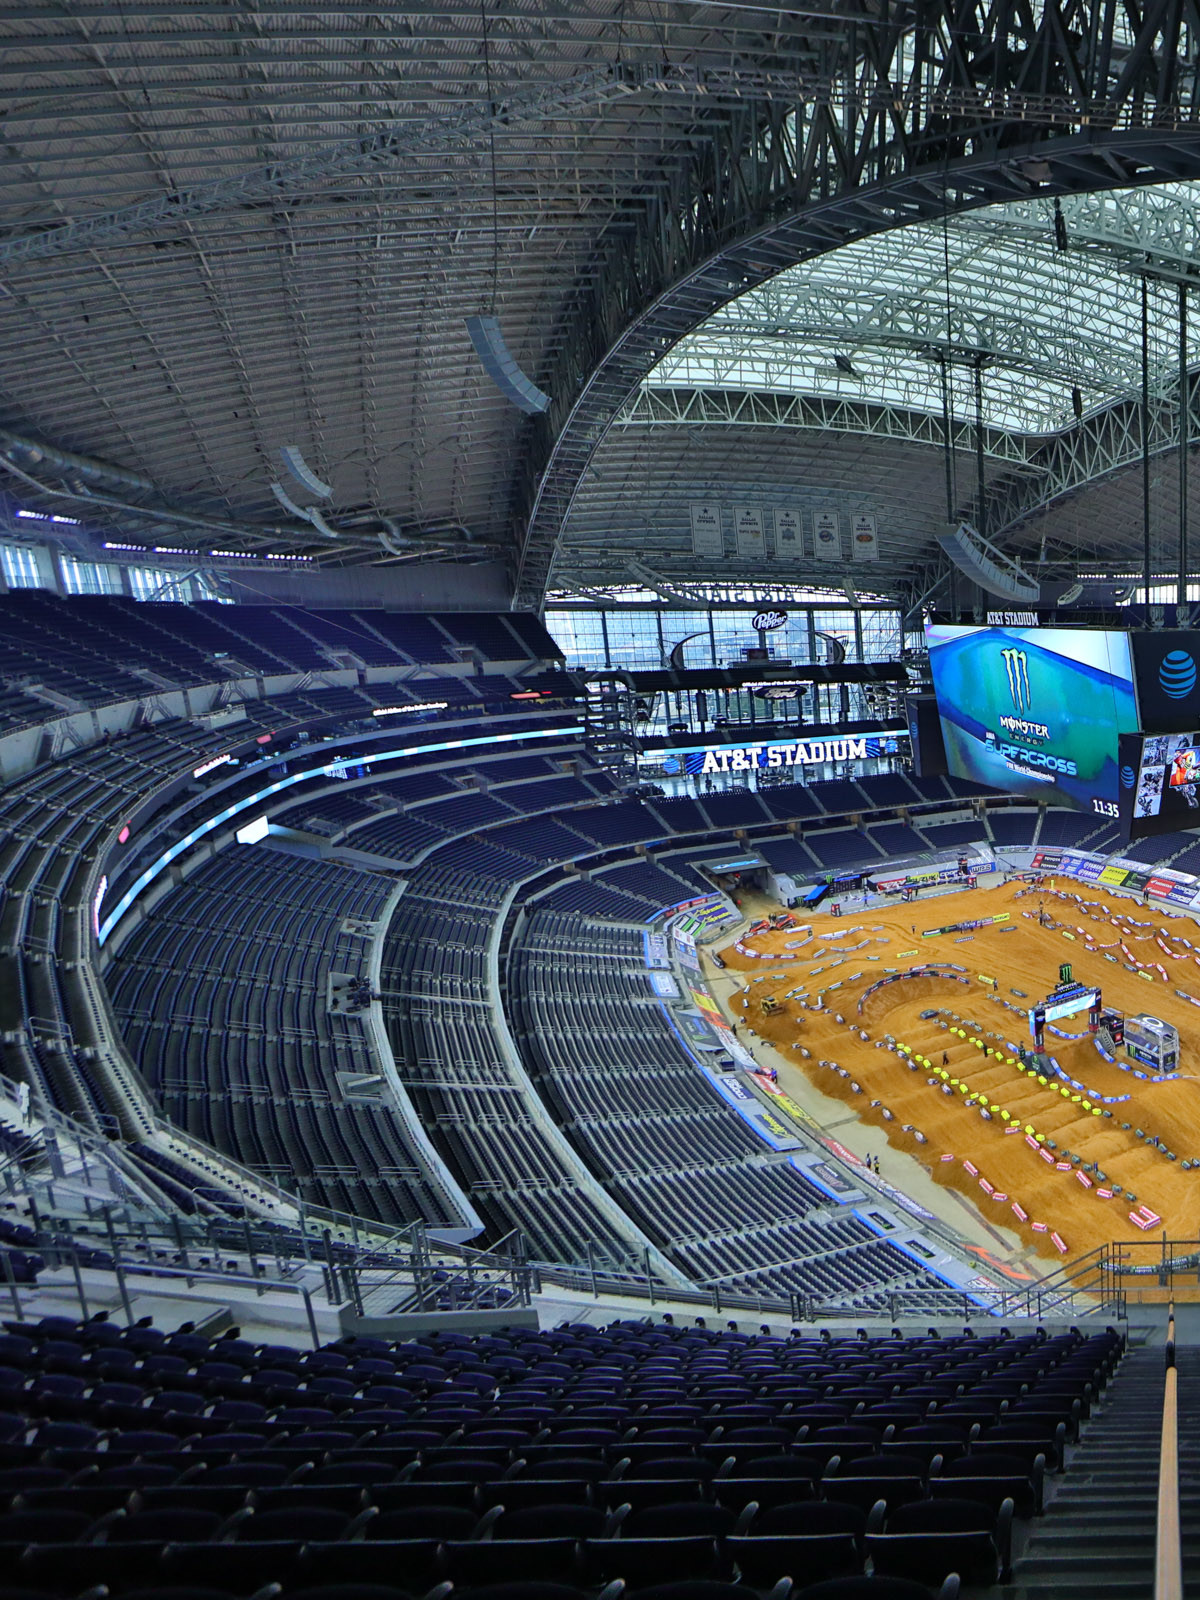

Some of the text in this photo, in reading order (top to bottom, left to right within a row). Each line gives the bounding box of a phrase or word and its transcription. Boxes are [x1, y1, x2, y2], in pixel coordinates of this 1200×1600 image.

[753, 614, 787, 629] Pepper
[767, 611, 779, 619] Dr
[987, 612, 1039, 626] AT&T STADIUM
[764, 688, 798, 699] Ford
[1000, 715, 1050, 740] MONSTER
[1009, 733, 1044, 746] ENERGY
[702, 738, 867, 774] AT&T STADIUM
[985, 739, 1077, 776] SUPERCROSS
[1093, 799, 1120, 818] 11:35
